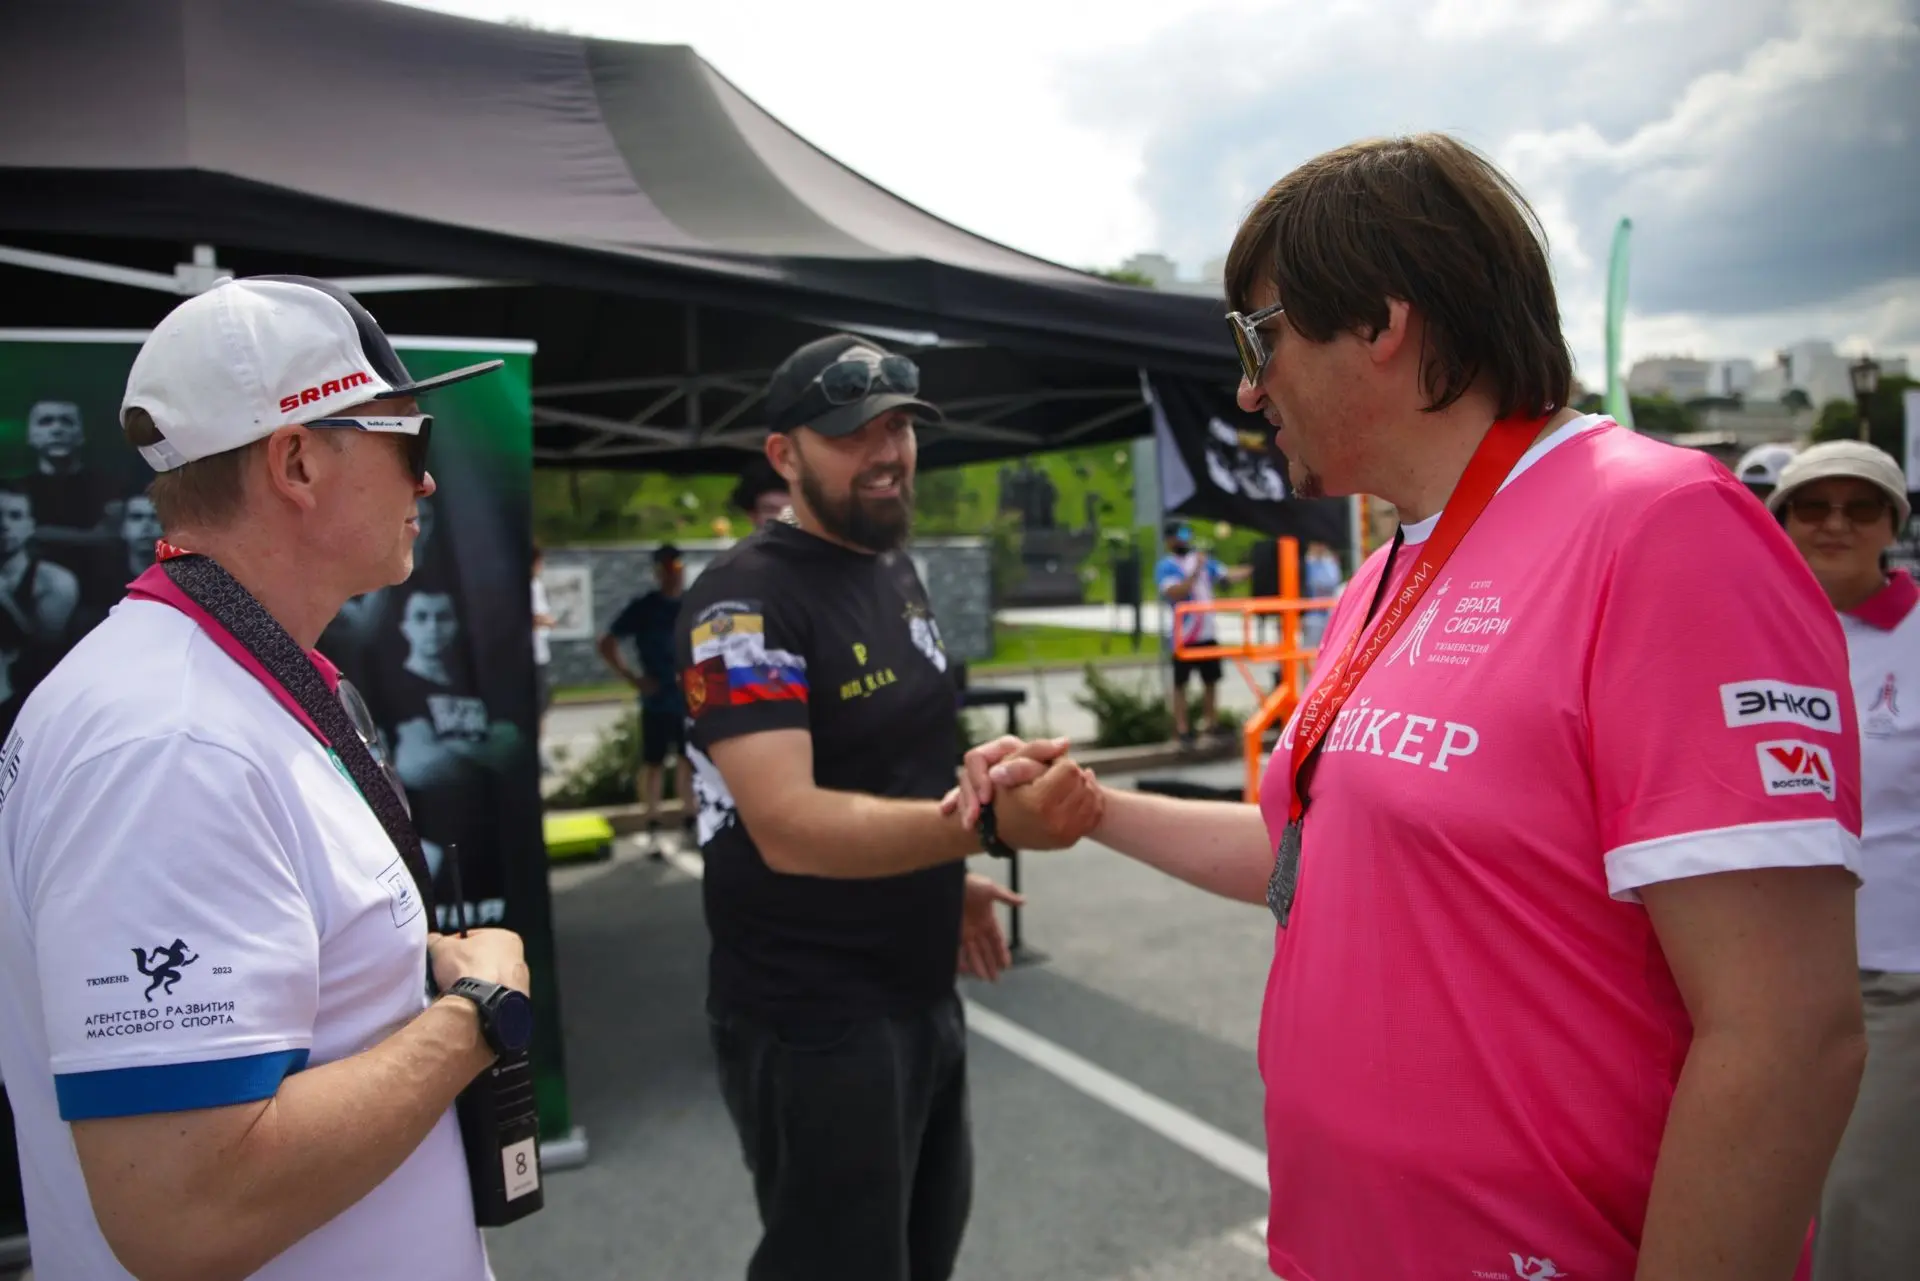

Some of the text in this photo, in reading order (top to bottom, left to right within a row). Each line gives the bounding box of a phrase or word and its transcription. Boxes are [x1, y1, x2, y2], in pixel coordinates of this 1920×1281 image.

[279, 371, 370, 414] SRAM
[1358, 562, 1433, 667] ЭМОЦИЯМИ
[1455, 597, 1501, 613] ВРАТА
[1444, 617, 1512, 635] СИБИРИ
[1435, 642, 1490, 653] ТЮМЕНСКИЙ
[1427, 654, 1471, 665] МАРАФОН
[1735, 690, 1832, 721] ЭНКО
[86, 975, 129, 987] ТЮМЕНЬ
[212, 967, 233, 975] 2023
[85, 1001, 235, 1025] АГЕНТСТВО РАЗВИТИЯ
[87, 1015, 234, 1040] МАССОВОГО СПОРТА
[515, 1152, 527, 1176] 8
